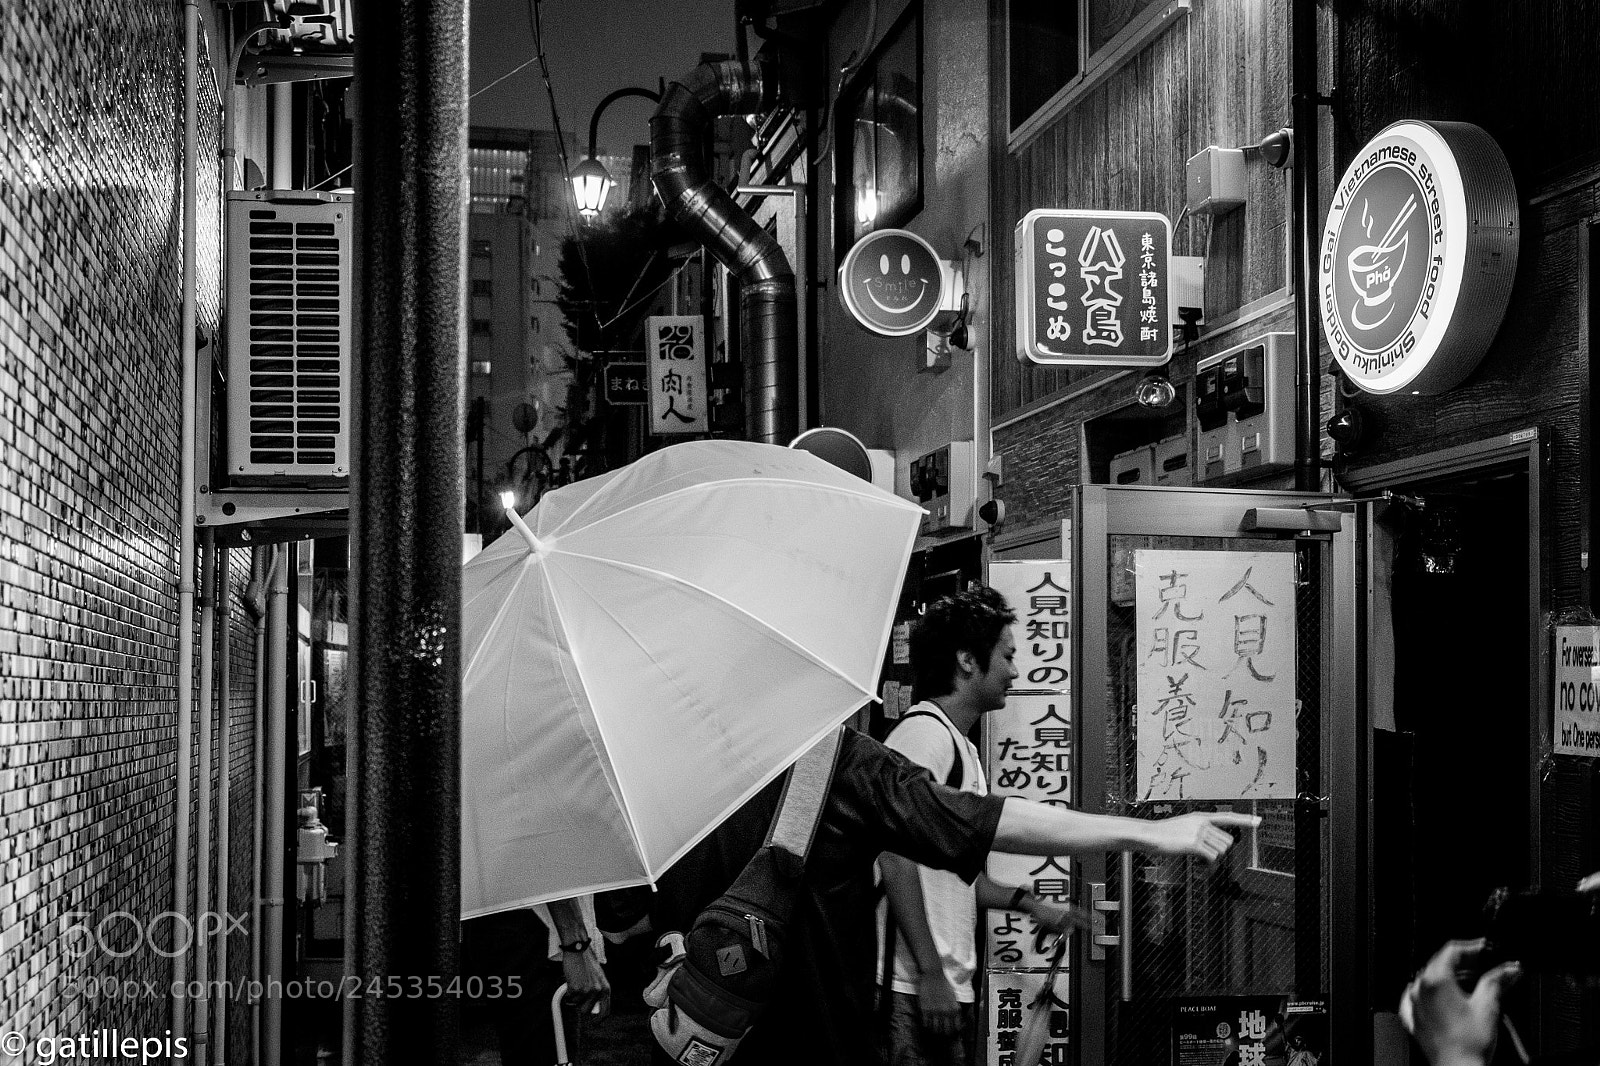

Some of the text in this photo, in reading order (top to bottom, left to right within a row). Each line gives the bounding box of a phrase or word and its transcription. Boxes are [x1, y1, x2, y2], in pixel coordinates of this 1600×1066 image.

[1045, 228, 1071, 341] こっこめ
[1334, 145, 1443, 319] Vietnamese street food
[1078, 225, 1126, 348] 八丈島
[1138, 232, 1159, 341] 東京諸島焼酎
[1322, 231, 1417, 375] Shinjuku Golden Gai
[661, 369, 695, 423] 肉人
[1025, 572, 1070, 684] 人見知りの
[1217, 566, 1276, 796] 人見知り
[1562, 637, 1571, 667] For
[1141, 570, 1210, 799] 克服養成所
[1560, 681, 1575, 711] no
[1562, 722, 1571, 745] but
[1573, 722, 1584, 747] One
[997, 737, 1031, 799] ため
[993, 913, 1023, 963] よる
[1029, 856, 1070, 963] 人見り
[1238, 1010, 1267, 1066] 地球
